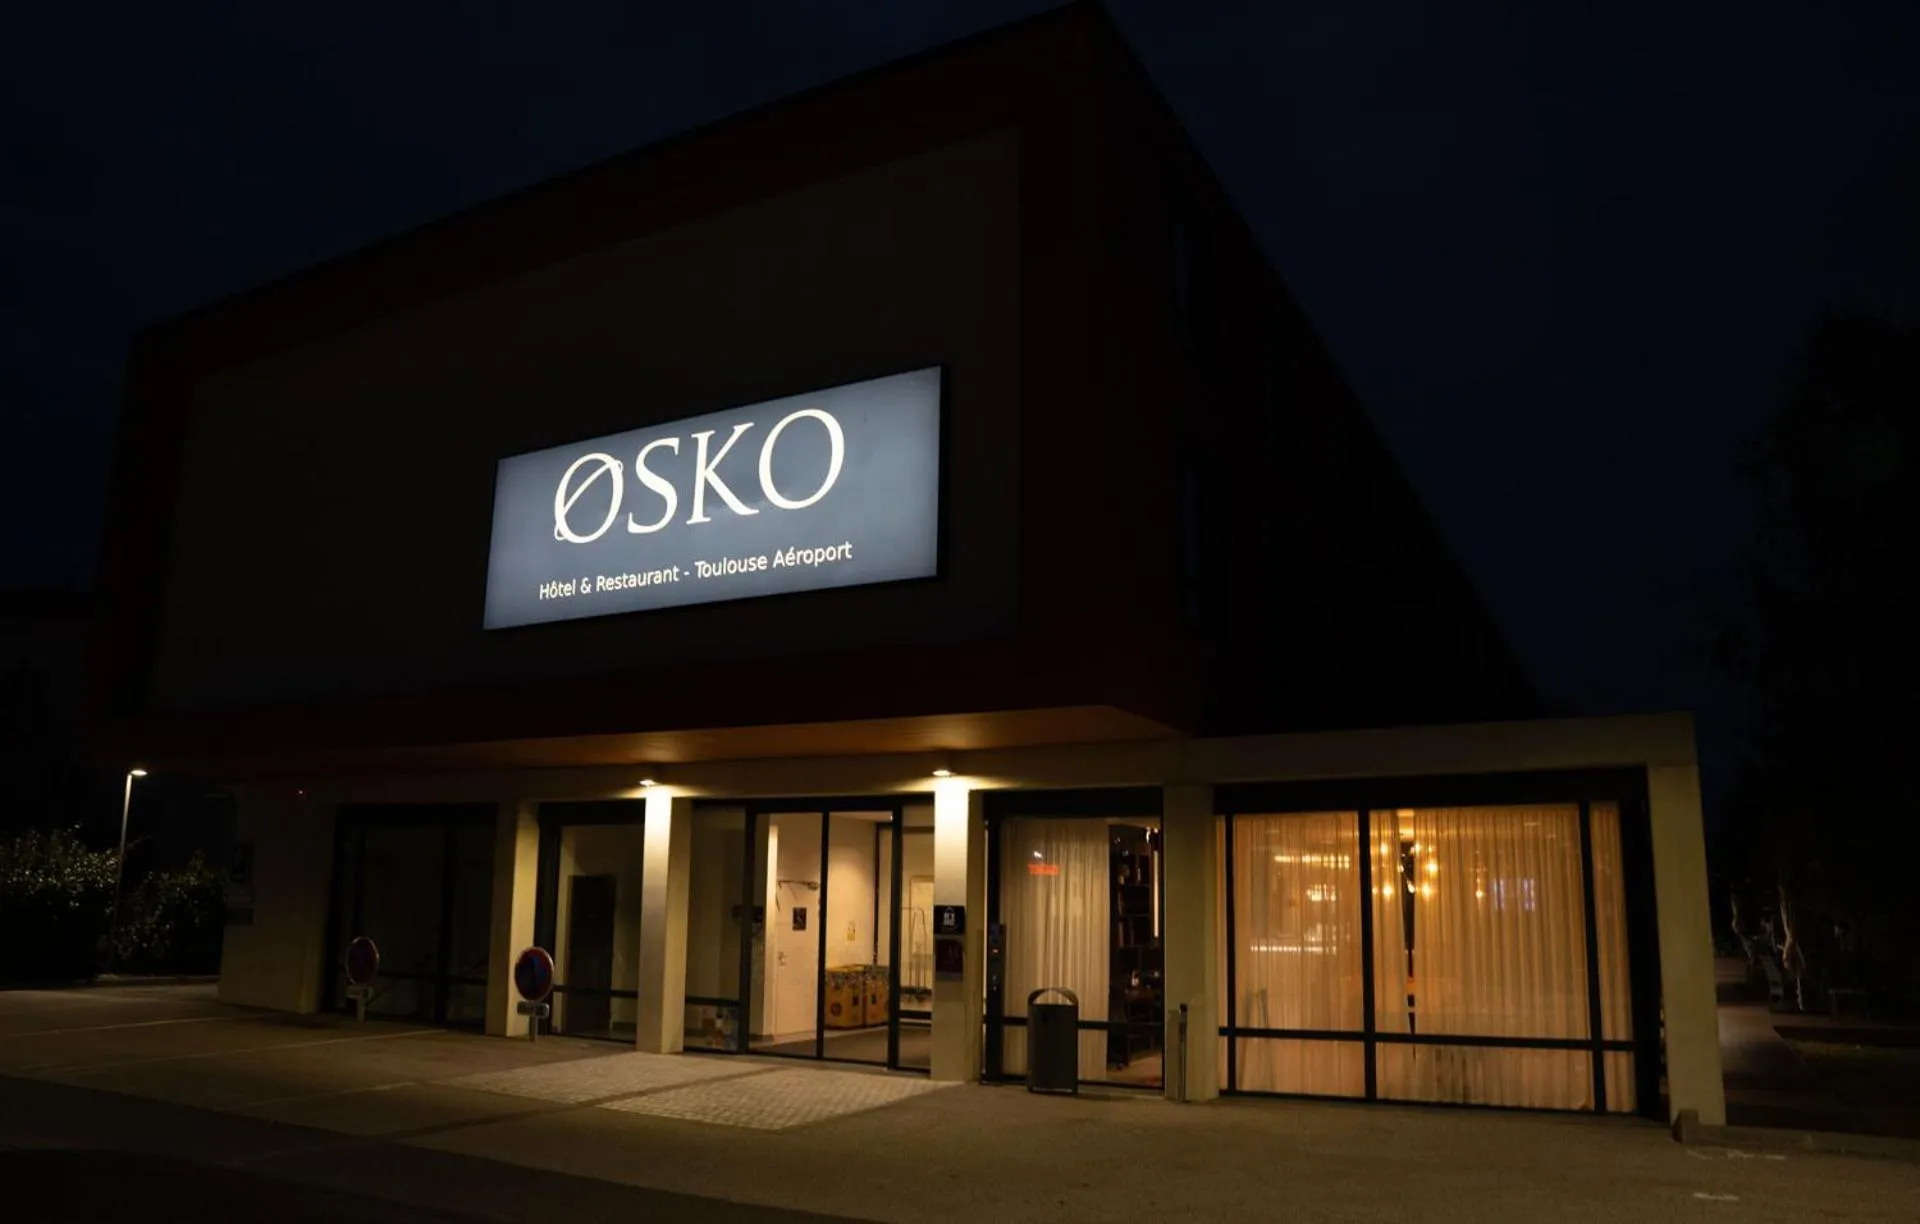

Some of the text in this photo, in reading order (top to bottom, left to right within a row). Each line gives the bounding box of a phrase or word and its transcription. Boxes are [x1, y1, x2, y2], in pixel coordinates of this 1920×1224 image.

[539, 578, 577, 600] Hôtel
[580, 577, 592, 594] &
[596, 565, 680, 592] Restaurant
[694, 554, 768, 579] Toulouse
[772, 540, 853, 569] Aéroport
